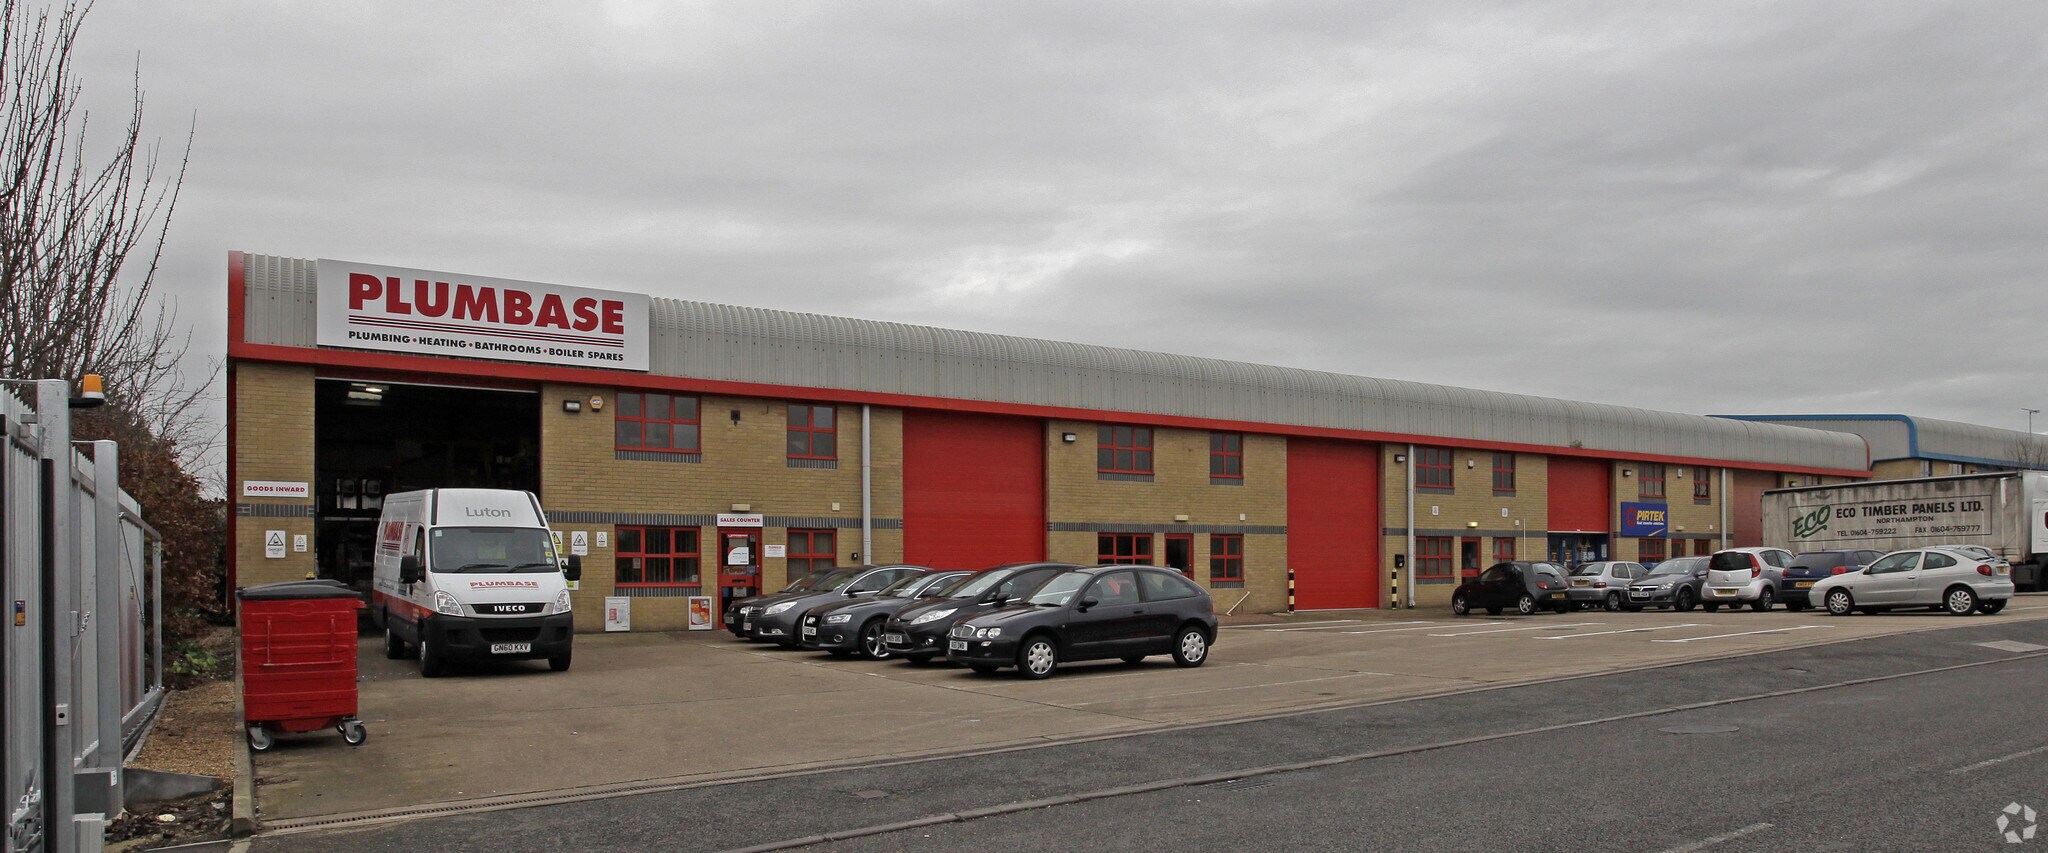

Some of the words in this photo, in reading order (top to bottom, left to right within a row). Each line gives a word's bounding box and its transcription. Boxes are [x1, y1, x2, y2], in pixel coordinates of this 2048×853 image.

[349, 272, 624, 335] PLUMBASE
[348, 330, 411, 344] PLUMBING
[418, 336, 467, 349] HEATING
[474, 341, 541, 355] BATHROOMS
[548, 347, 584, 359] BOILER
[588, 351, 624, 361] SPARES
[465, 506, 512, 518] Luton
[1836, 507, 1856, 519] ECO
[1861, 504, 1907, 517] TIMBER
[1912, 501, 1955, 514] PANELS
[1961, 500, 1985, 512] LTD.
[1636, 510, 1665, 522] PIRTEK
[1792, 504, 1831, 538] ECO
[1876, 516, 1934, 524] NORTHAMPTON
[1914, 526, 1927, 534] FAX
[494, 644, 513, 652] GN60
[514, 643, 529, 652] KXV
